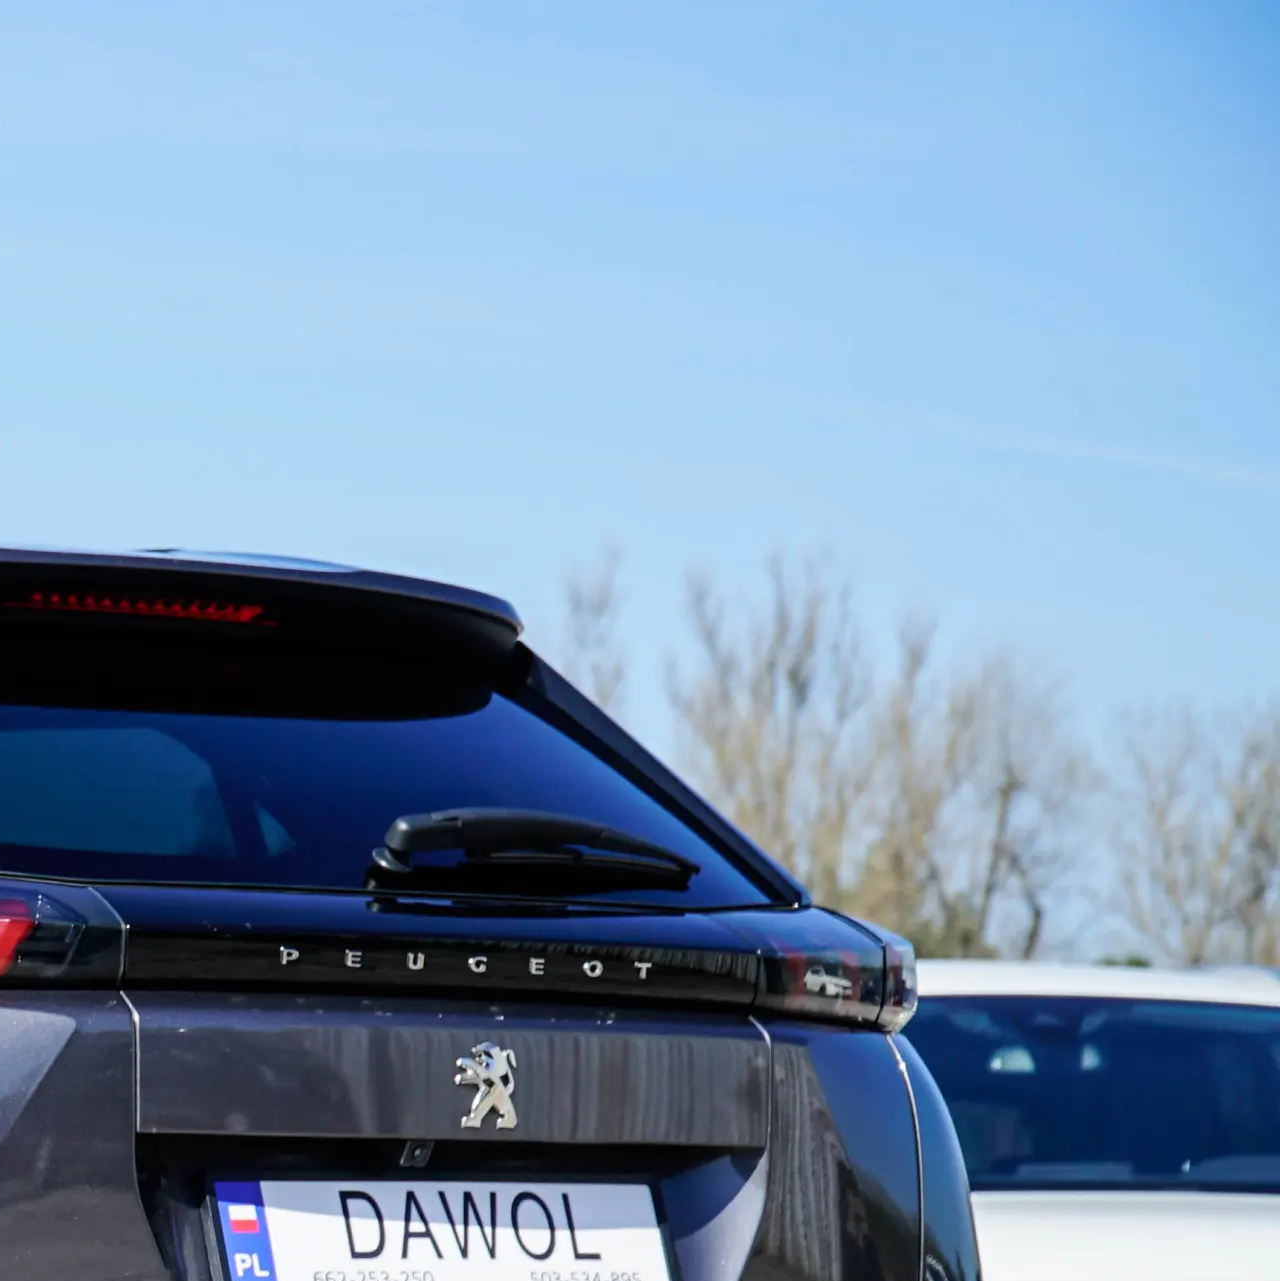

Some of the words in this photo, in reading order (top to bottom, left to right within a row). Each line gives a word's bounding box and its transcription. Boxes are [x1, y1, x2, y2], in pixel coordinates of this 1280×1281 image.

[279, 945, 653, 980] PEUGEOT
[338, 1189, 601, 1261] DAWOL
[233, 1252, 270, 1279] PL
